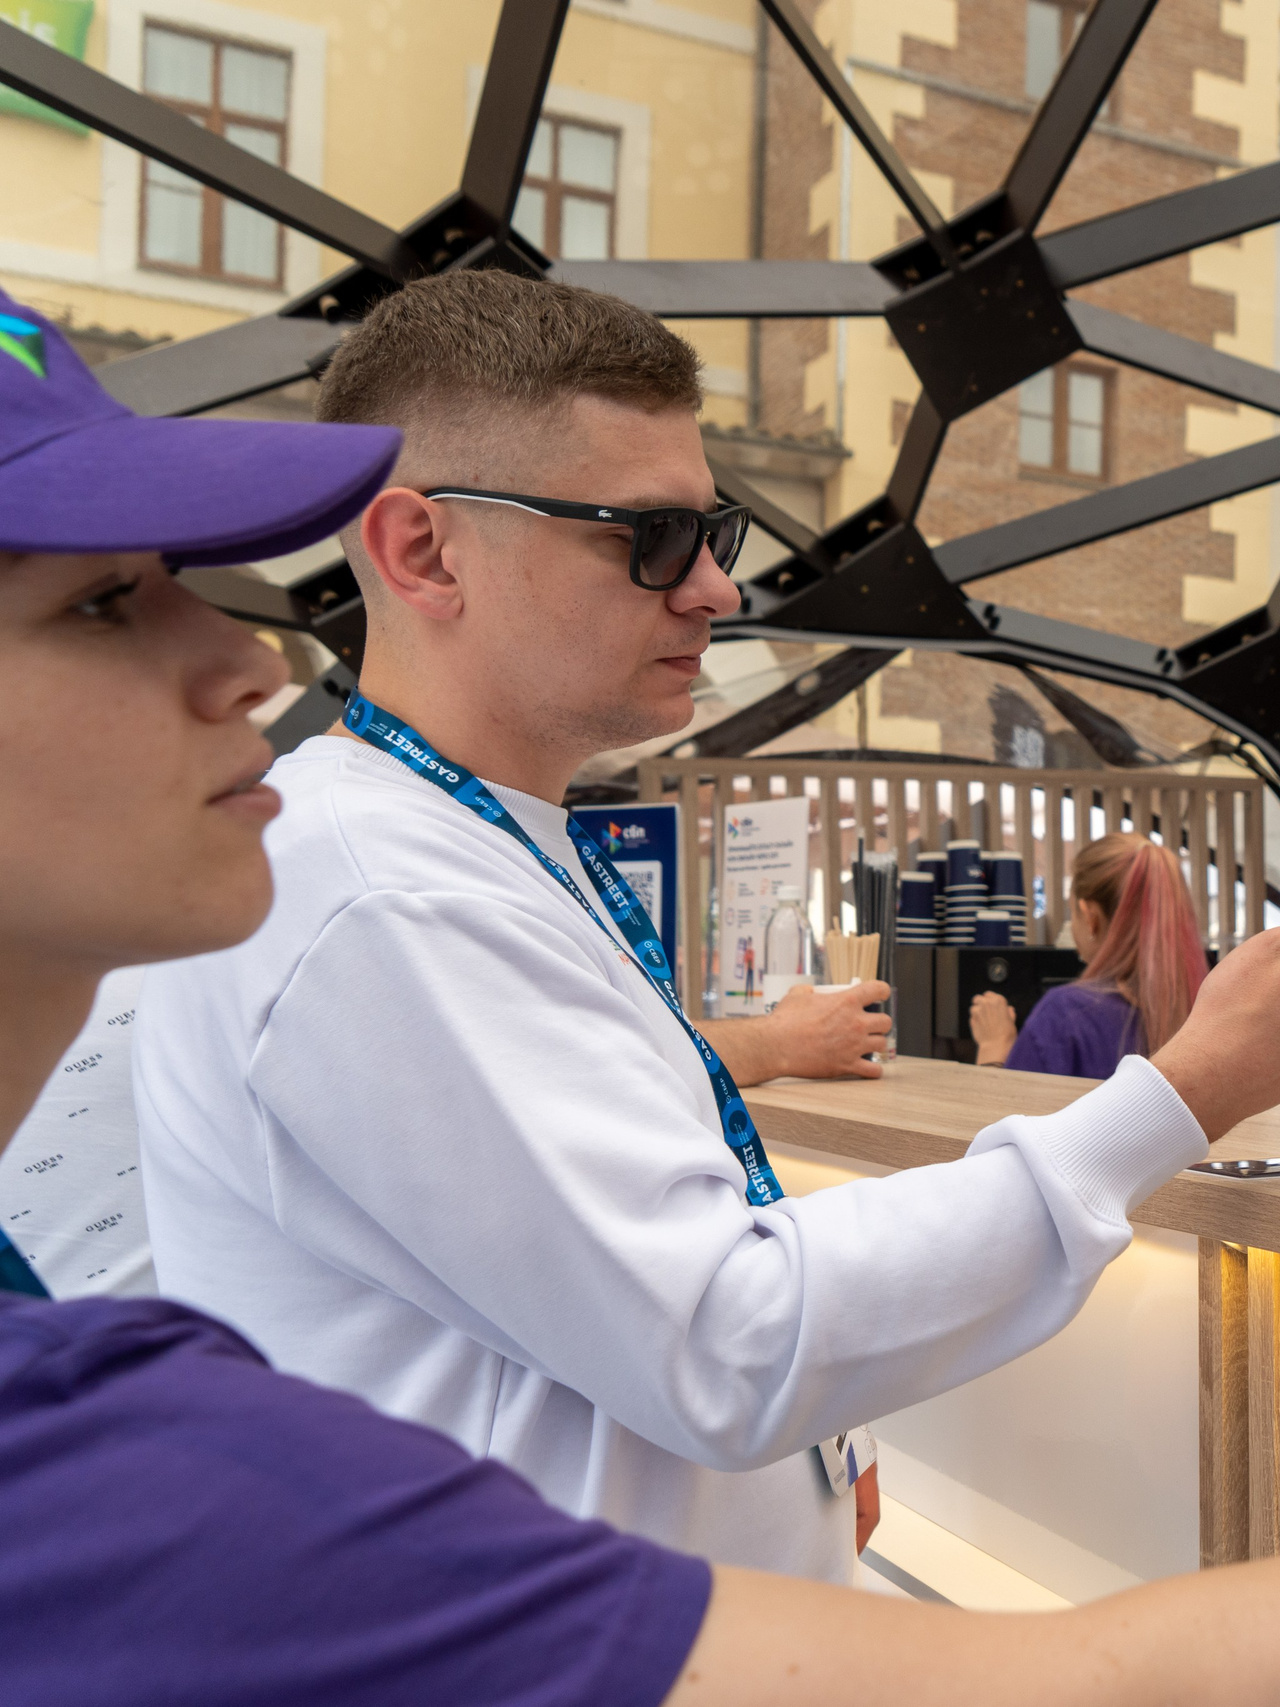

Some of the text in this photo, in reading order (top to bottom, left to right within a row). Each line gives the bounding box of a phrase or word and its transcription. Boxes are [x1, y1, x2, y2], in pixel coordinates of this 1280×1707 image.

[384, 729, 460, 783] GASTREET
[582, 846, 630, 909] GASTREET
[107, 1008, 136, 1026] GUES
[64, 1052, 103, 1073] GUESS
[24, 1153, 64, 1174] GUESS
[742, 1144, 775, 1203] ASTREET
[85, 1212, 124, 1233] GUESS
